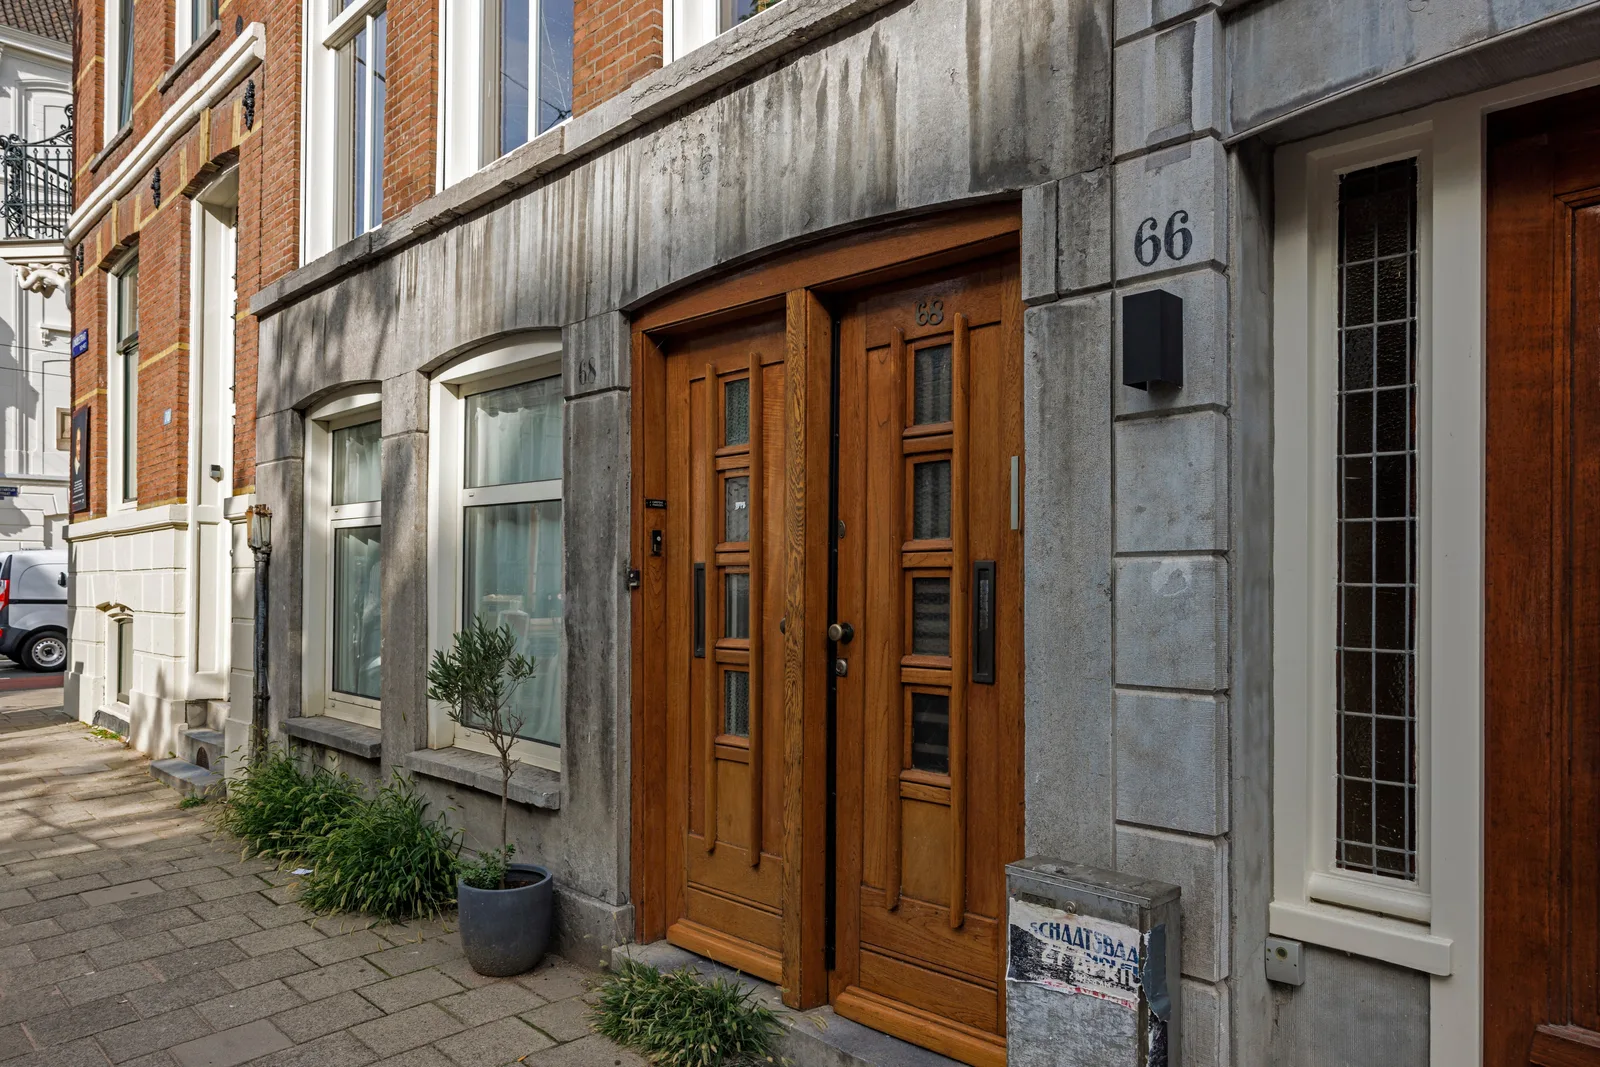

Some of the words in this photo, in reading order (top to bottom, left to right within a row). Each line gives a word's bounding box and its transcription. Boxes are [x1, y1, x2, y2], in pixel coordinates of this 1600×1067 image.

[1134, 210, 1193, 267] 66
[915, 299, 944, 327] 68
[578, 356, 597, 386] 68
